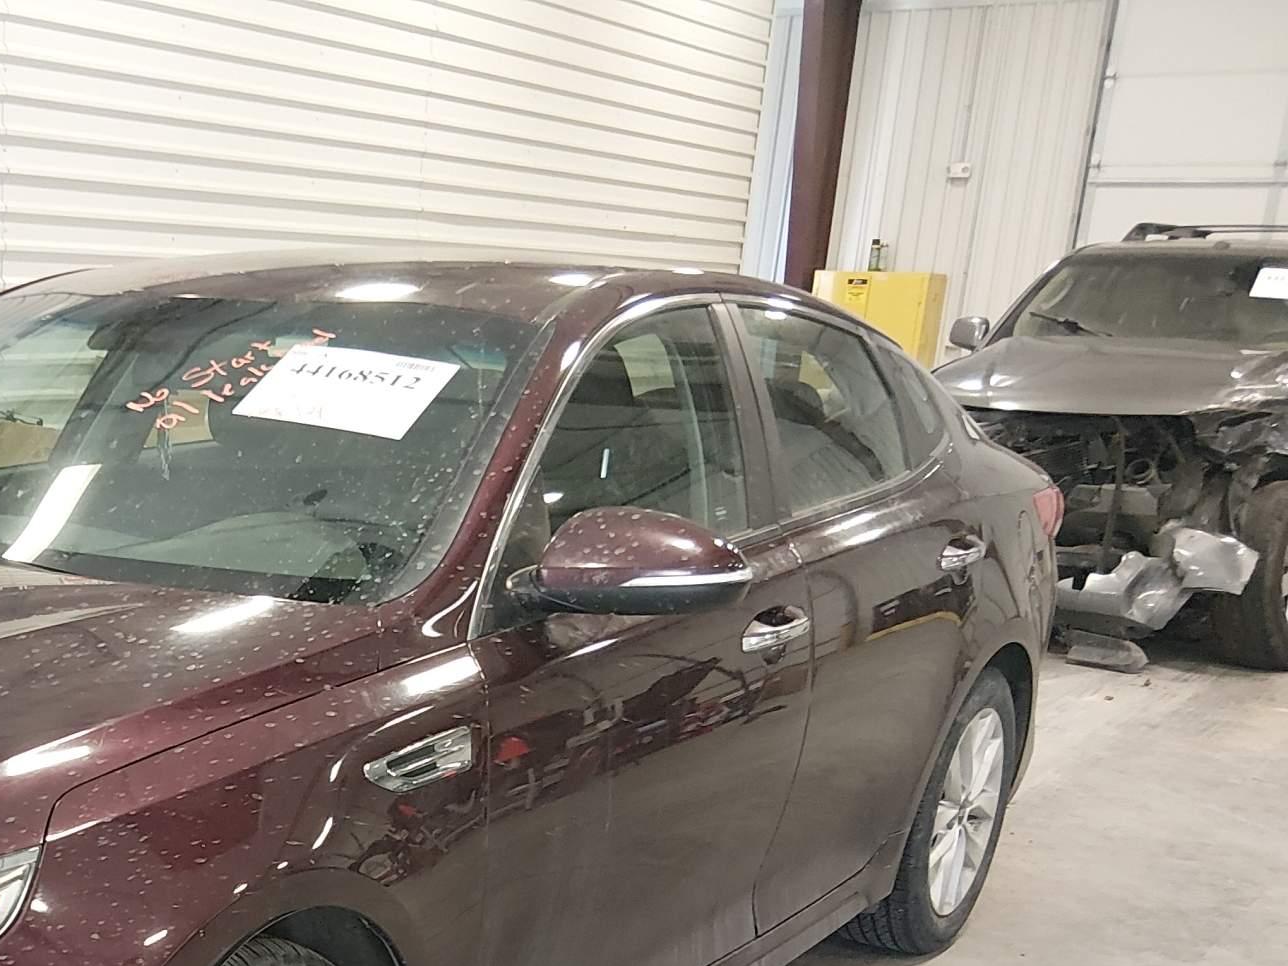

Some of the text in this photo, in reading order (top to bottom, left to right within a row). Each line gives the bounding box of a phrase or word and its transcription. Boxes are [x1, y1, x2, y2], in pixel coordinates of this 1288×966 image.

[126, 388, 169, 413] No
[182, 339, 272, 388] Start
[290, 362, 421, 390] 44168512
